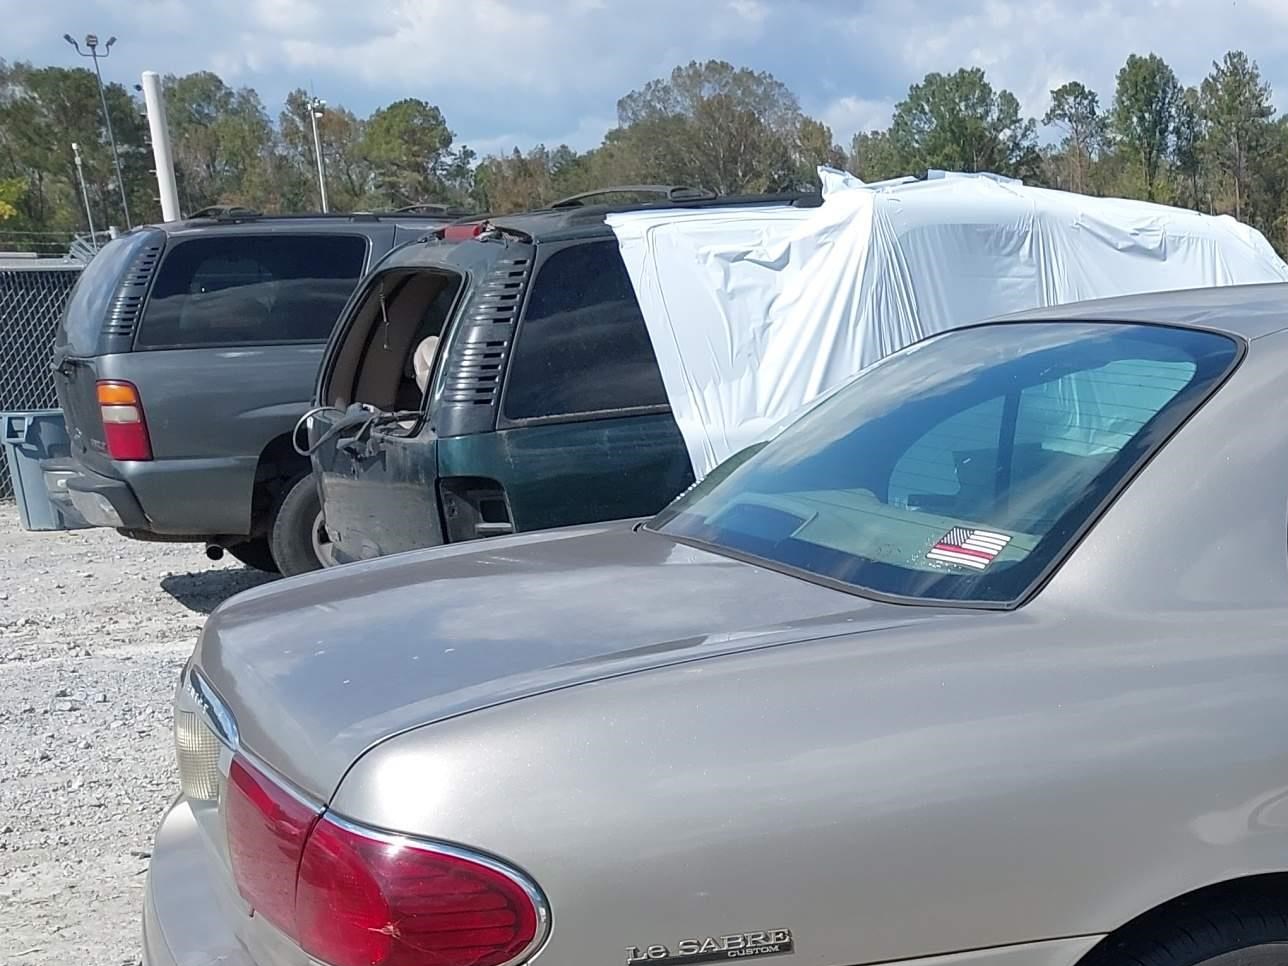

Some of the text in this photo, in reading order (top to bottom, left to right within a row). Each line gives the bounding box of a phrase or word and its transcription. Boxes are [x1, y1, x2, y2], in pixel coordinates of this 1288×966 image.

[626, 928, 793, 963] Le SABRE
[727, 944, 780, 958] CUSTOM
